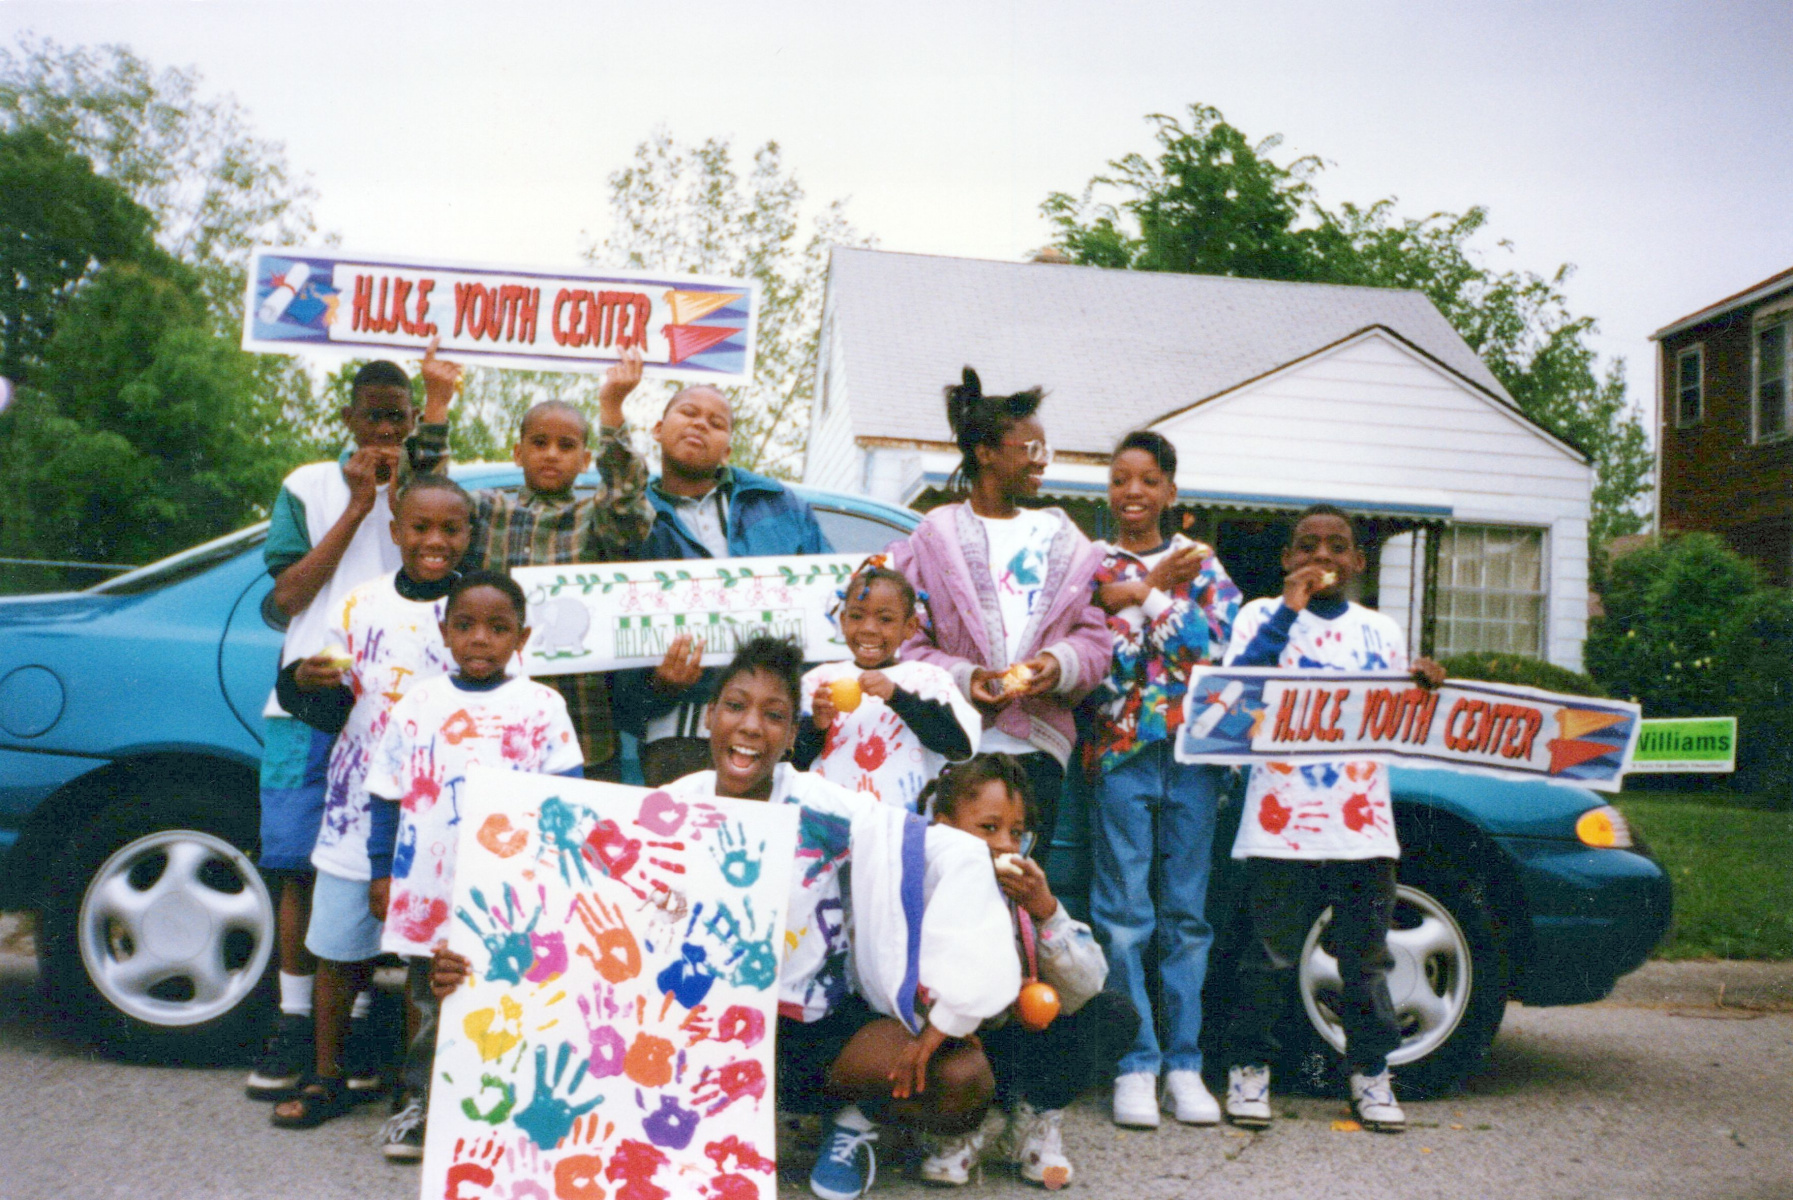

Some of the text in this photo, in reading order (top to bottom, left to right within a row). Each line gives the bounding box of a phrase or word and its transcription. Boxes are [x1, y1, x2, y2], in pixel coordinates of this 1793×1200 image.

[453, 281, 540, 345] YOUTH
[552, 287, 652, 352] CENTER
[1356, 687, 1440, 745] YOUTH
[1443, 696, 1543, 761] CENTER
